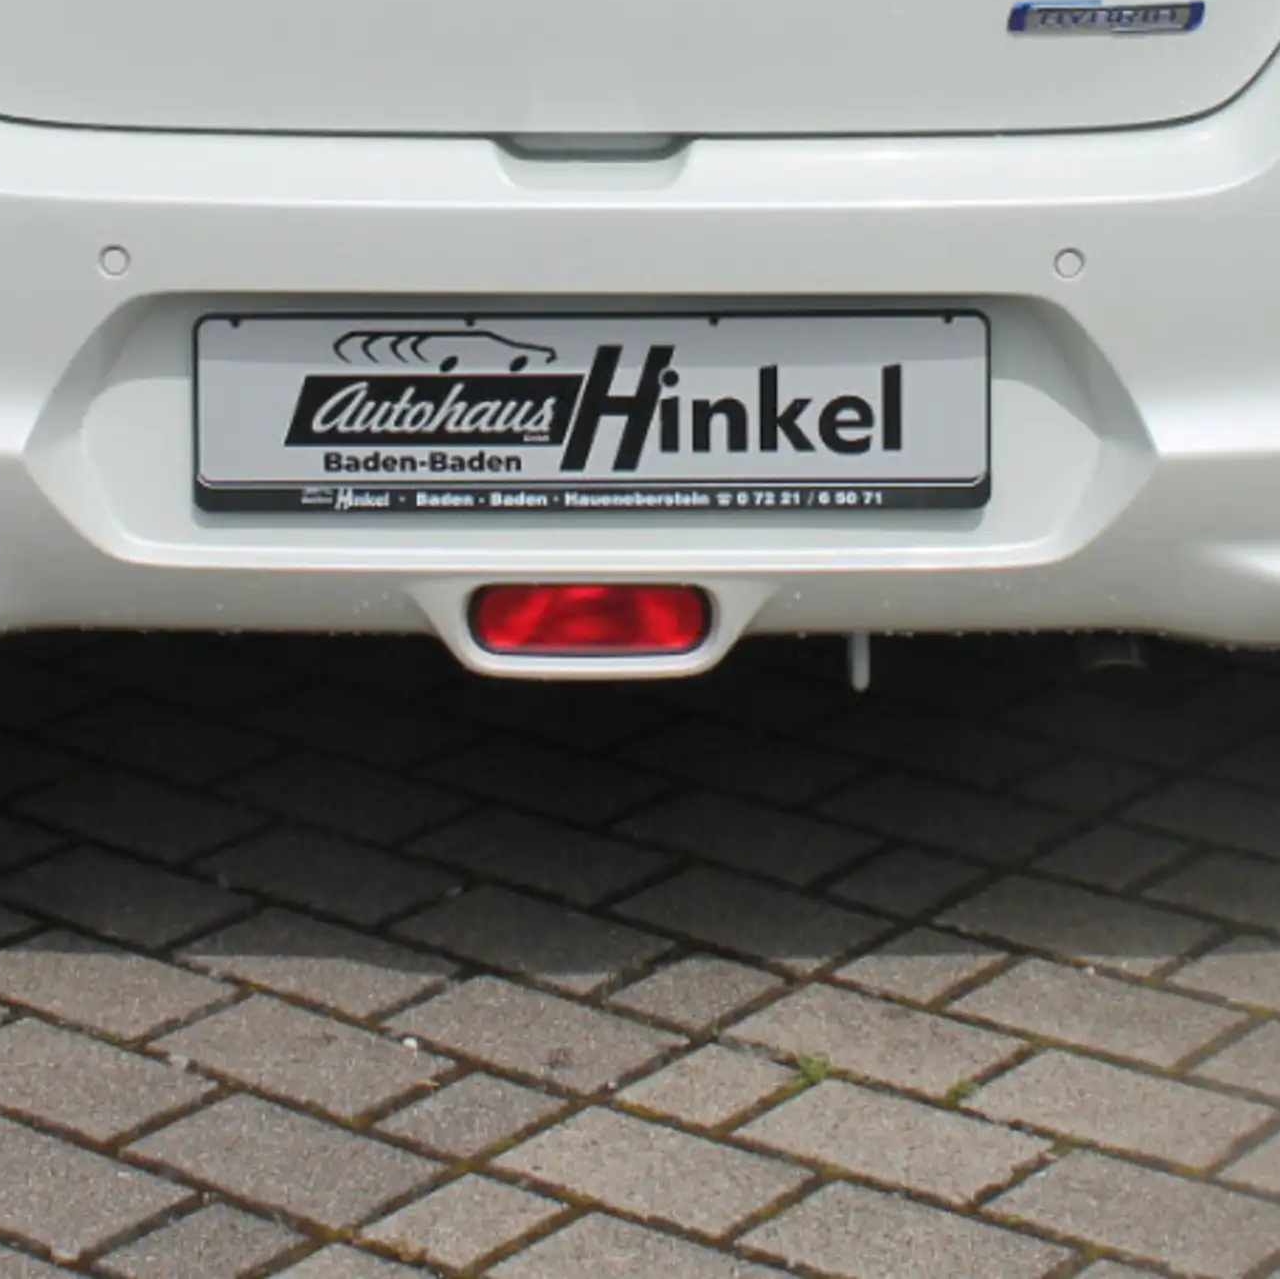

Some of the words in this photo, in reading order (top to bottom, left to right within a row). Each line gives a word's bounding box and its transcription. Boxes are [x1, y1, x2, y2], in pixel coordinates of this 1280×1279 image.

[312, 381, 557, 432] Autohaus
[559, 344, 902, 472] Hinkel
[324, 451, 522, 473] Baden-Baden
[416, 491, 474, 507] Baden
[490, 491, 548, 507] Baden
